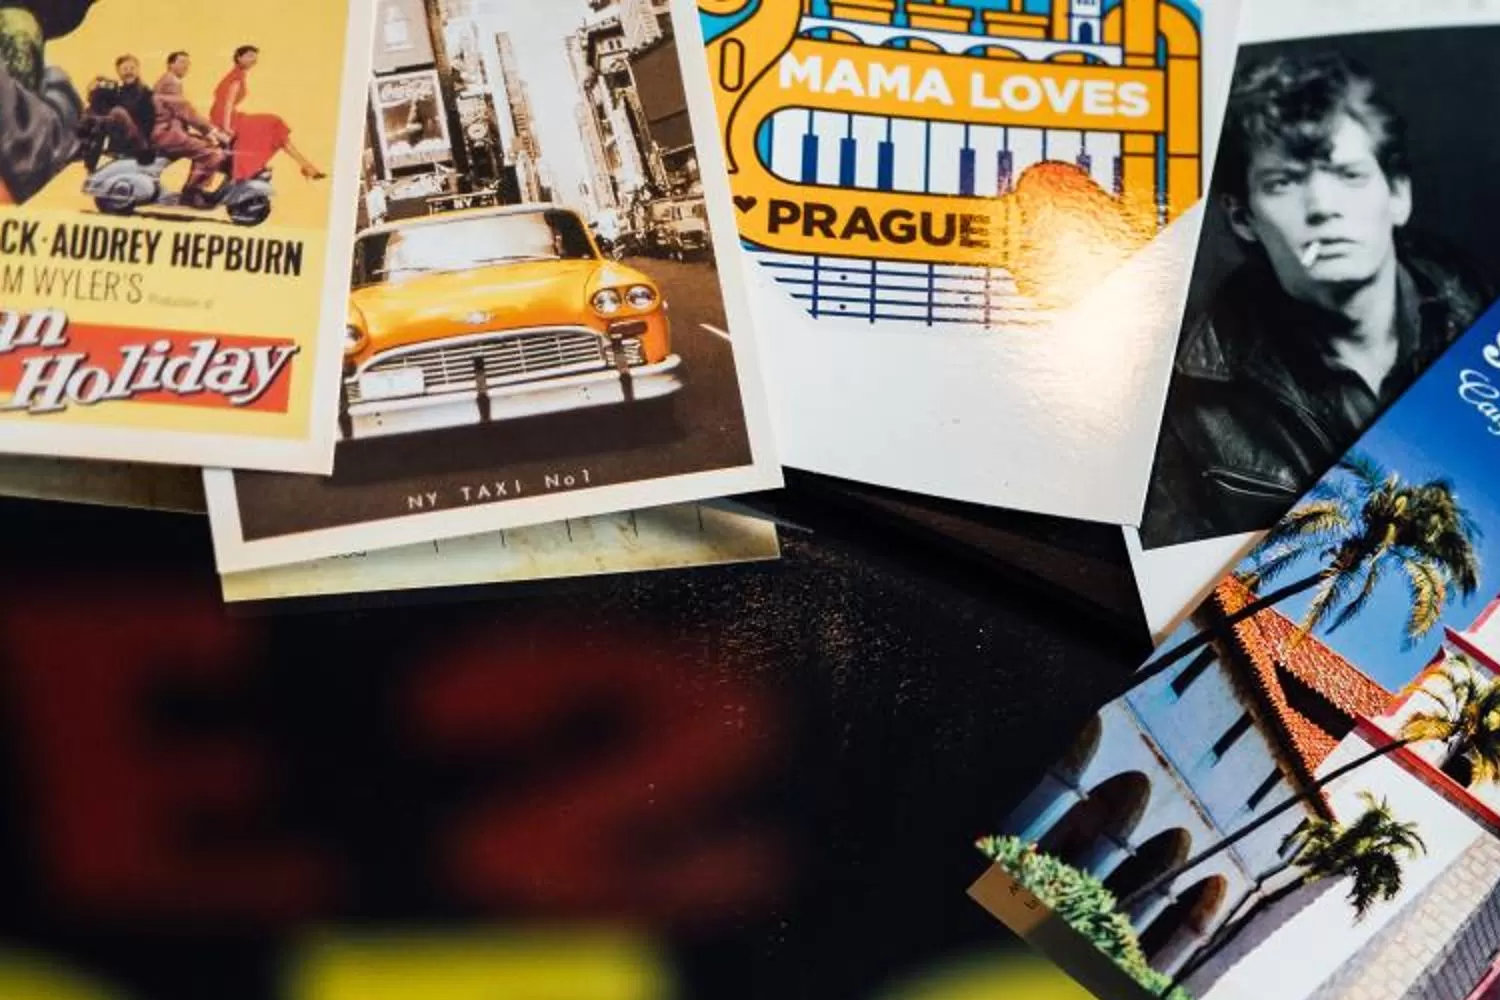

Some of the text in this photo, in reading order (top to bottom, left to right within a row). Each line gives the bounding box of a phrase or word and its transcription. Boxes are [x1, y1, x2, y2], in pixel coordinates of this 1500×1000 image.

[778, 52, 1151, 118] MAMA LOVES
[767, 198, 992, 249] PRAGUE
[50, 223, 163, 266] AUDREY
[170, 231, 305, 277] HEPBURN
[34, 265, 144, 305] WYLER'S
[0, 337, 301, 416] Holiday
[407, 490, 438, 510] NY
[459, 479, 522, 502] TAXI
